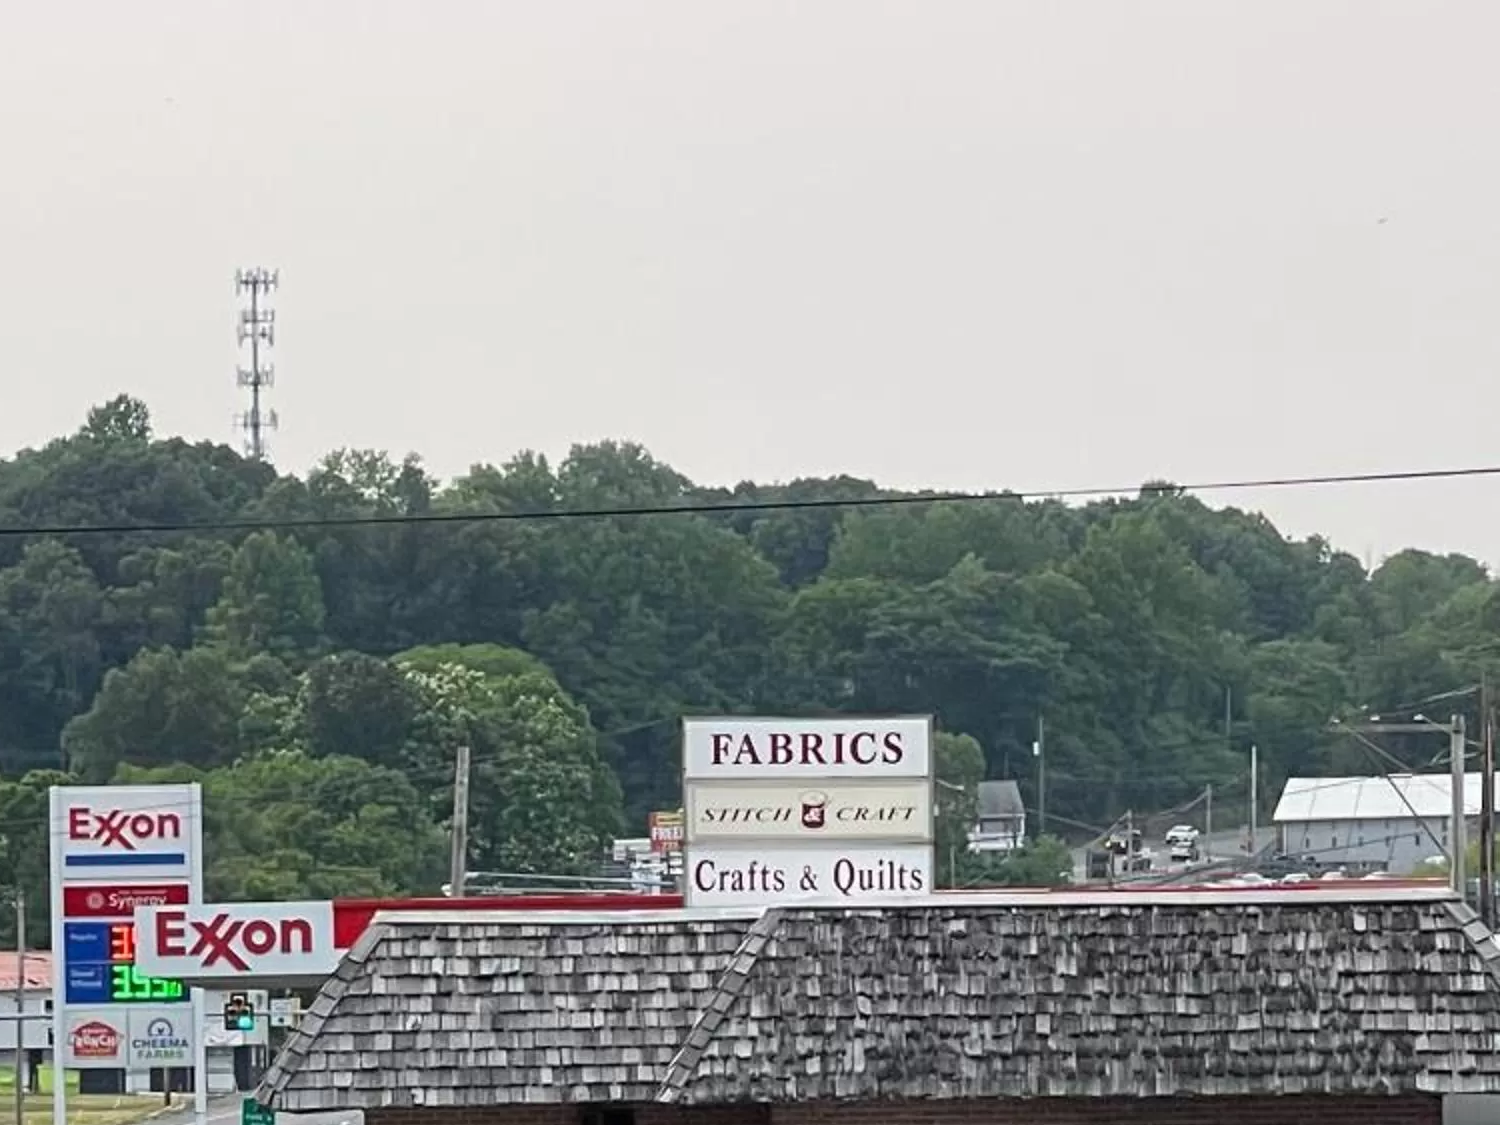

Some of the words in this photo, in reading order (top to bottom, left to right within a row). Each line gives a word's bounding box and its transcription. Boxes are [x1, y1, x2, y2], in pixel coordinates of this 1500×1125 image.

[710, 731, 904, 766] FABRICS
[69, 808, 181, 850] Exxon
[700, 807, 793, 822] STITCH
[835, 806, 917, 822] CRAFT
[694, 858, 785, 892] Crafts
[799, 864, 820, 892] &
[833, 858, 924, 896] Quilts
[155, 910, 313, 971] Exxon
[132, 1038, 189, 1049] CHEEMA
[136, 1049, 185, 1060] FARMS
